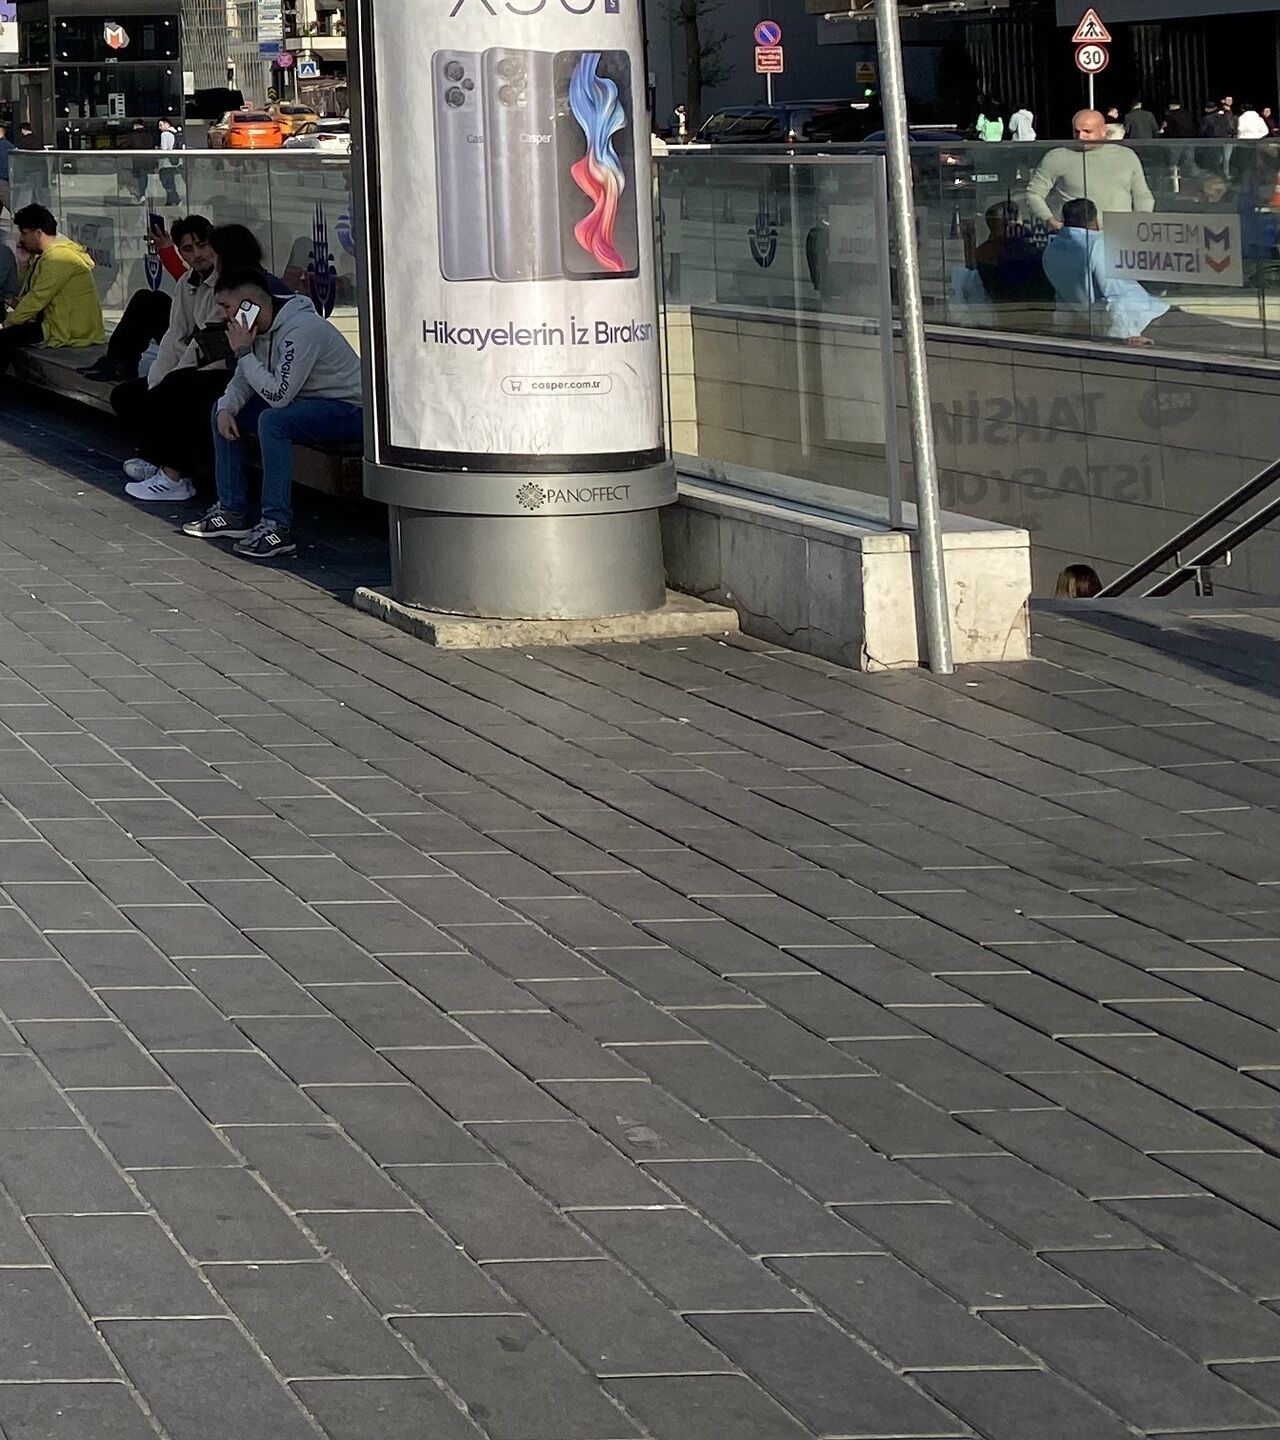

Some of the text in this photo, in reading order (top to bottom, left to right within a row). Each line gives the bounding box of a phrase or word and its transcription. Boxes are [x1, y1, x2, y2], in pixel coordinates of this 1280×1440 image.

[1083, 51, 1101, 65] 30
[519, 133, 551, 144] Casper
[423, 320, 564, 351] Hikayelerin
[571, 316, 589, 345] İz
[532, 380, 601, 391] casper.com.tr
[547, 485, 631, 503] PANOFFECT
